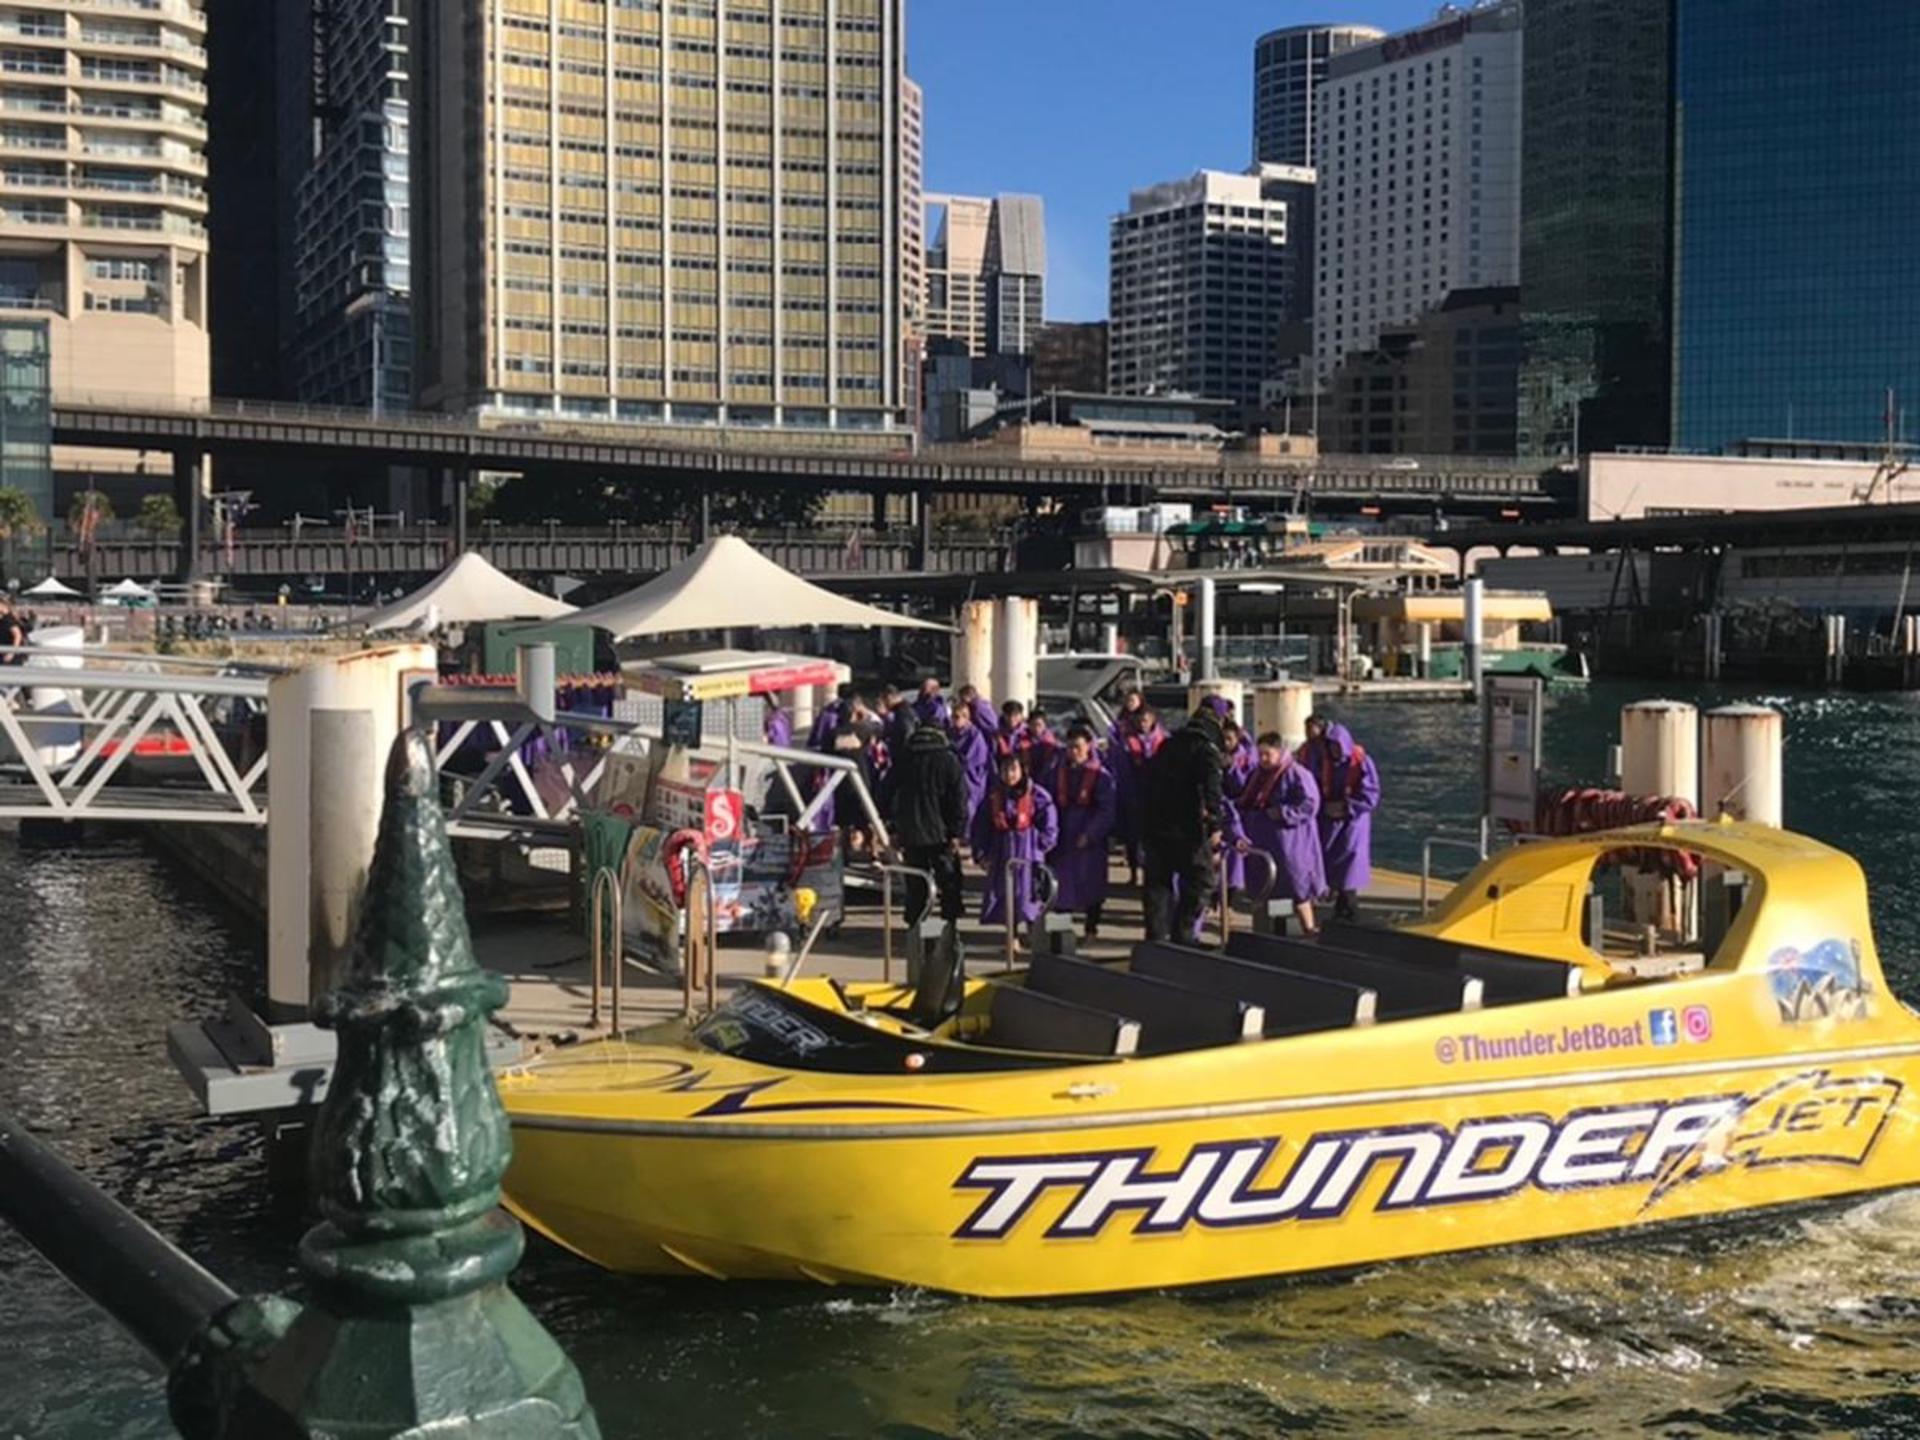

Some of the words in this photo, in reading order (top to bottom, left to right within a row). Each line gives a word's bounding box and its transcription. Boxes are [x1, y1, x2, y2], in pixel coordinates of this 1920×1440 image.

[1435, 1021, 1643, 1064] @ThunderJetBoat
[952, 1092, 1742, 1238] THUNDER
[1735, 1096, 1881, 1142] JET
